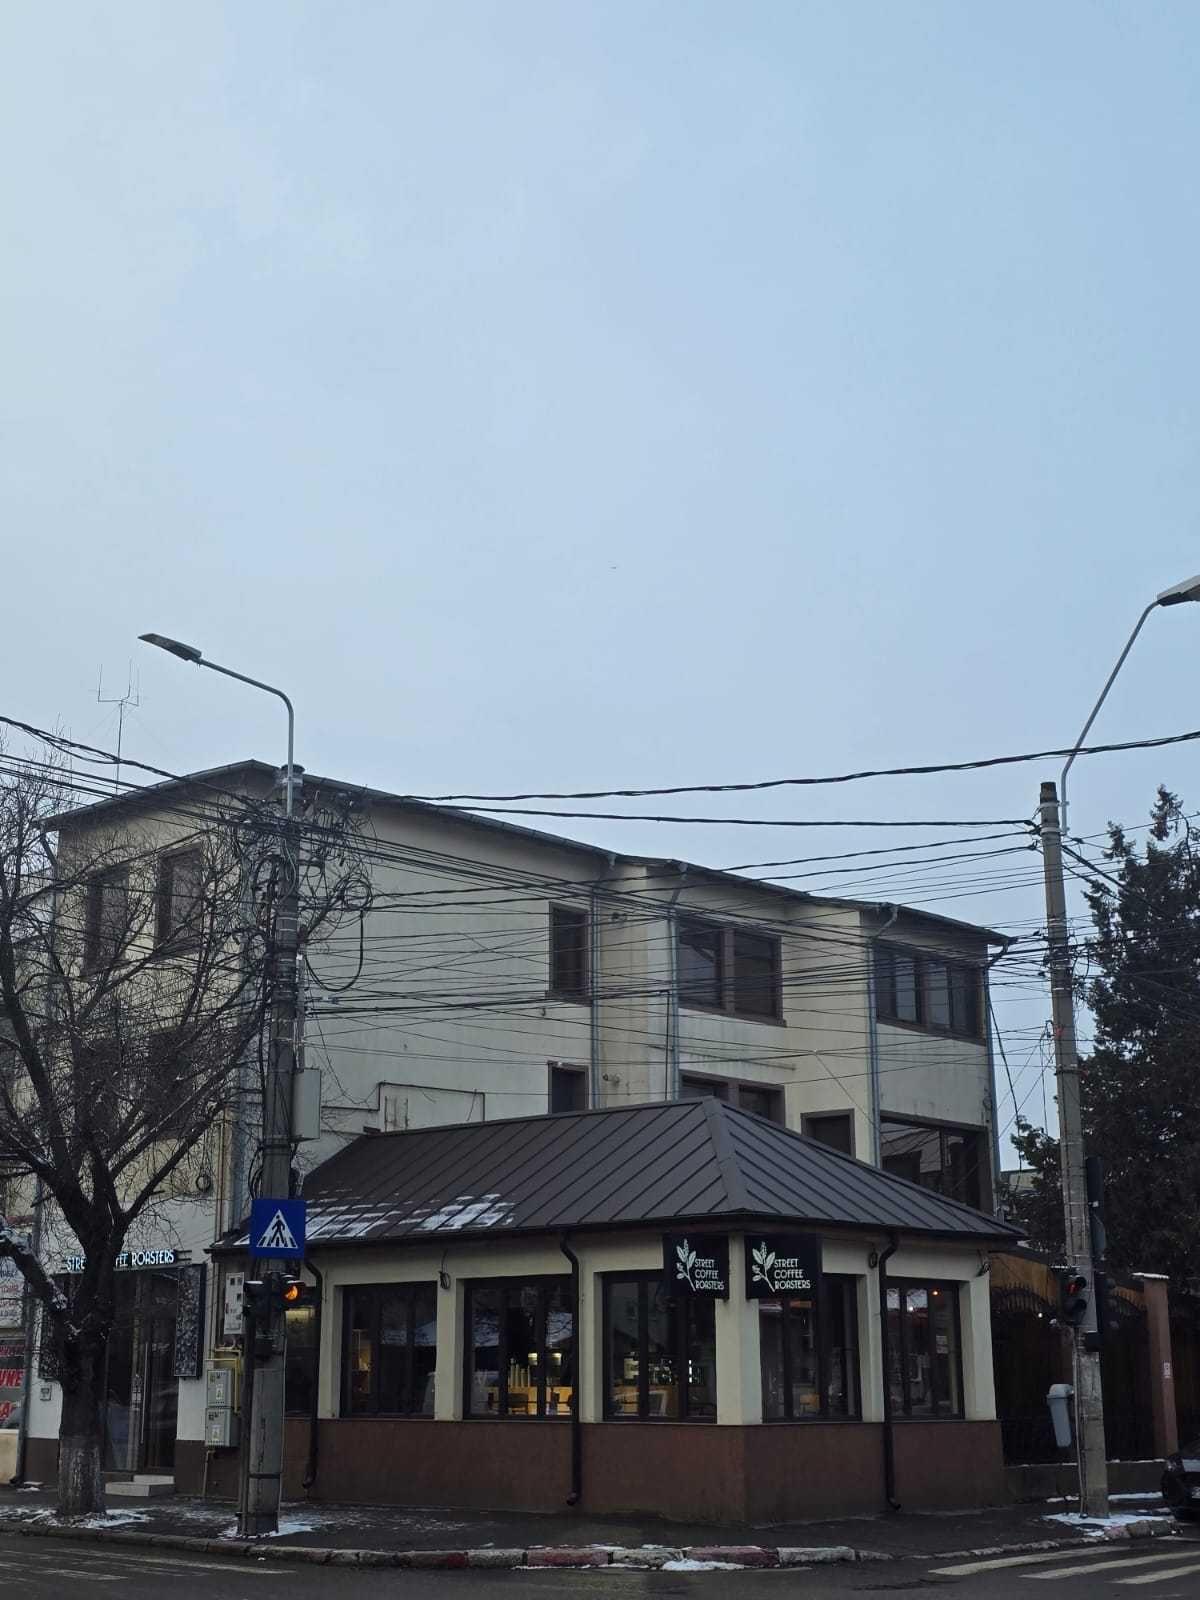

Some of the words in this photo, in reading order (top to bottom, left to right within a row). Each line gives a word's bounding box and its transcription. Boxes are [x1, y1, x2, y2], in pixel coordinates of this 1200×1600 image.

[66, 1256, 86, 1271] STRE
[131, 1248, 175, 1266] ROASTERS
[694, 1258, 715, 1268] STREET
[774, 1258, 799, 1268] STREET
[694, 1269, 719, 1279] COFFEE
[774, 1269, 804, 1279] COFFEE
[695, 1280, 725, 1290] ROASTERS
[775, 1280, 811, 1290] ROASTERS
